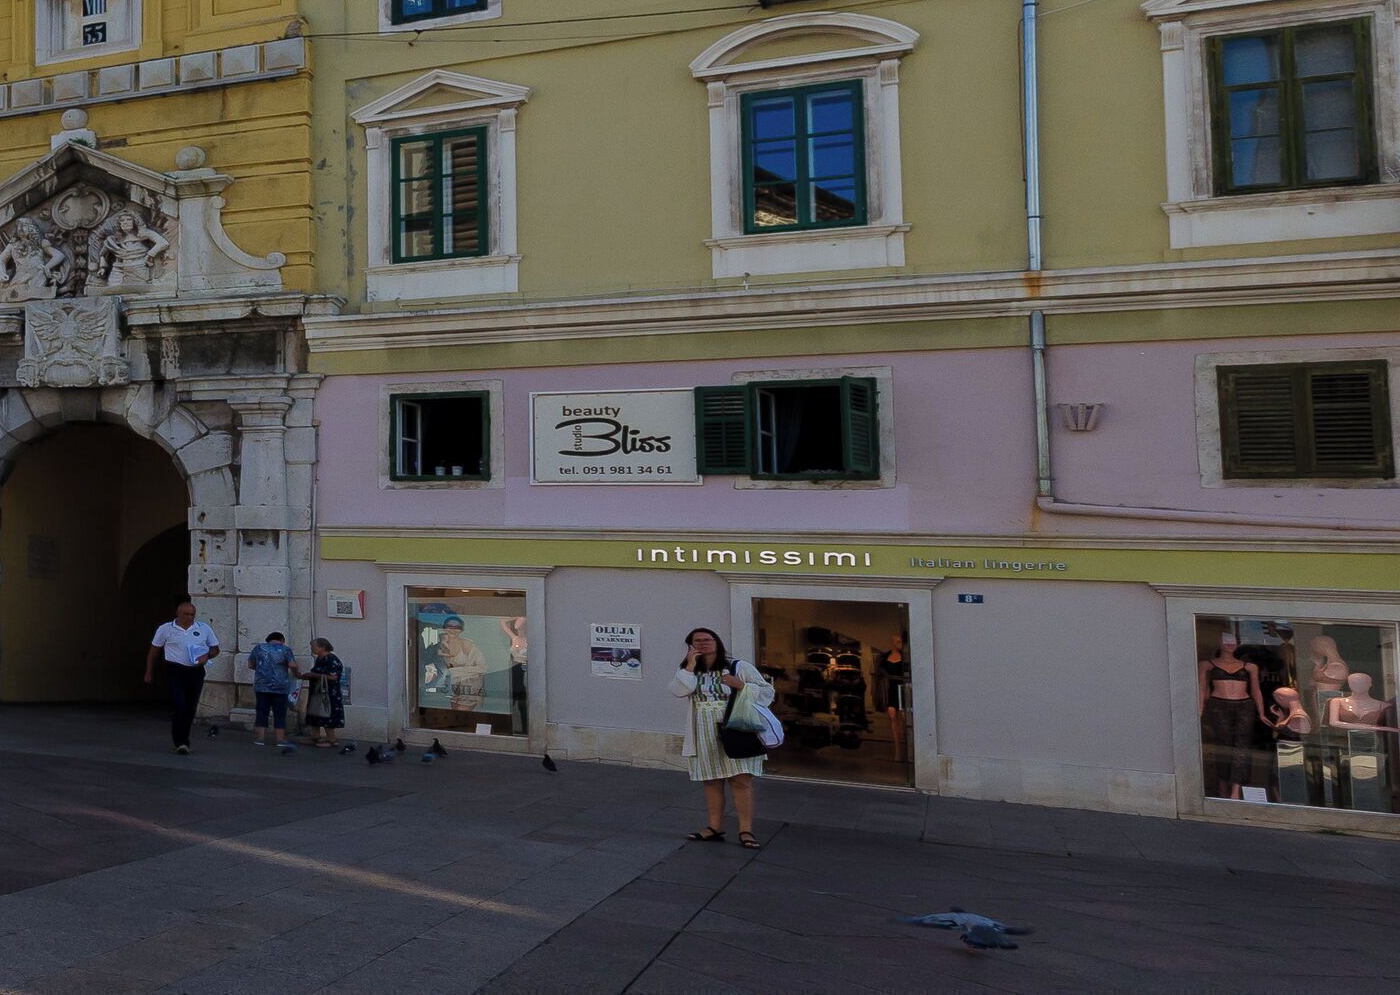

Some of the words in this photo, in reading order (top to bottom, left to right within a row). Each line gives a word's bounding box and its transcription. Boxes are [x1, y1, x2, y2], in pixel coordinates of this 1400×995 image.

[562, 405, 621, 418] beauty
[555, 417, 671, 457] Bliss
[572, 425, 583, 451] studio
[559, 466, 579, 475] tel.
[582, 466, 605, 475] 091
[609, 466, 633, 475] 981
[637, 466, 653, 475] 34
[656, 465, 673, 474] 61
[636, 546, 872, 567] intimissimi
[983, 558, 1068, 573] lingerie
[595, 625, 635, 635] OLUJA
